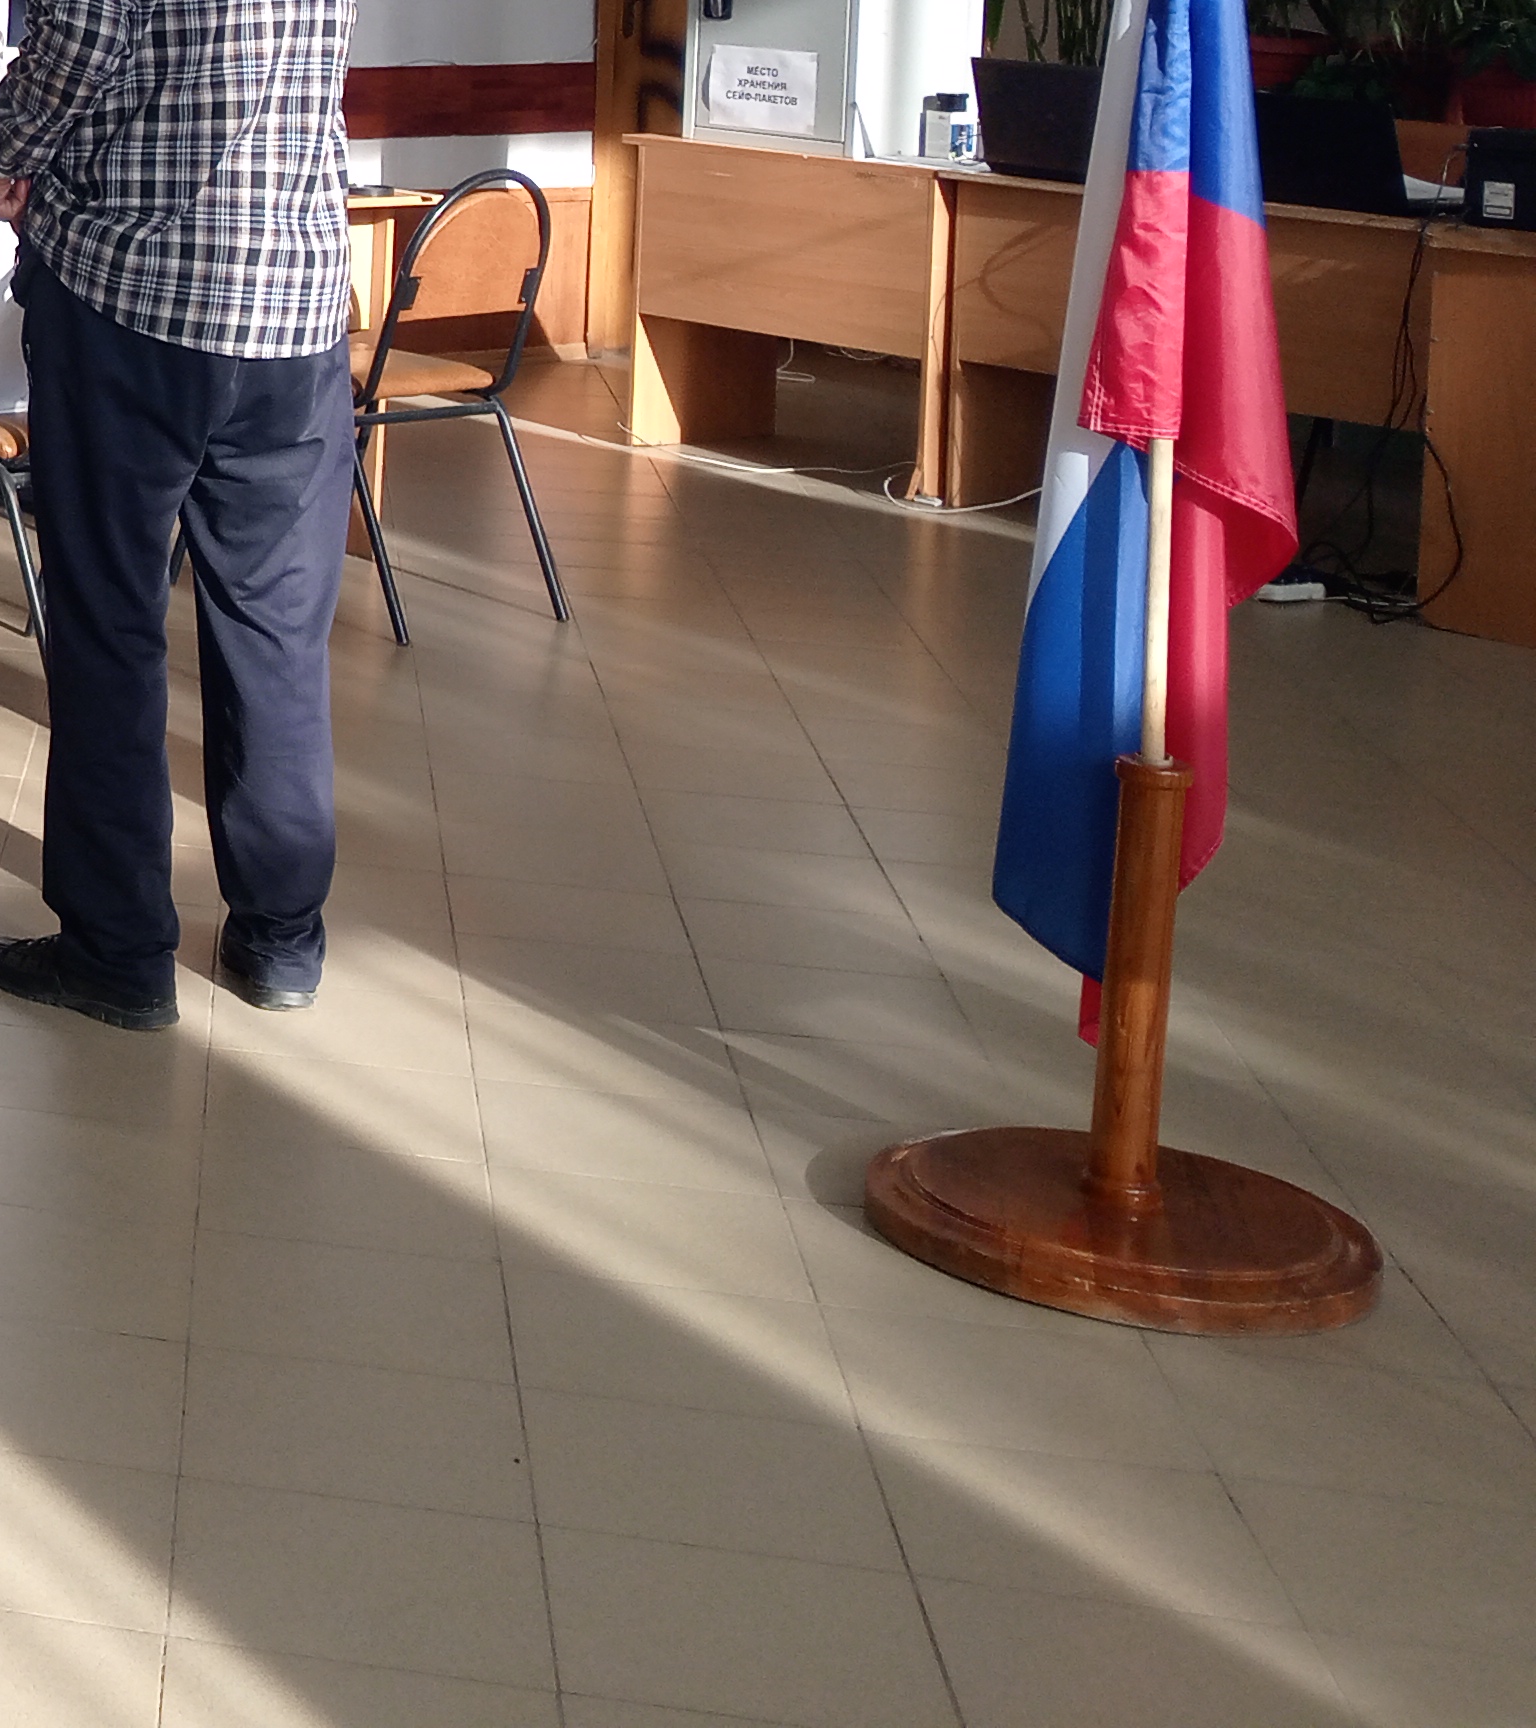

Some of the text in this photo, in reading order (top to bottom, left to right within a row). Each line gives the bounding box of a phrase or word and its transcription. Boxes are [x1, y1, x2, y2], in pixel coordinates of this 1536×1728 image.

[747, 66, 778, 77] МЕСТО
[737, 78, 787, 91] ХРАНЕНИЯ
[726, 89, 798, 106] СЕЙФ-ПАКЕТОВ
